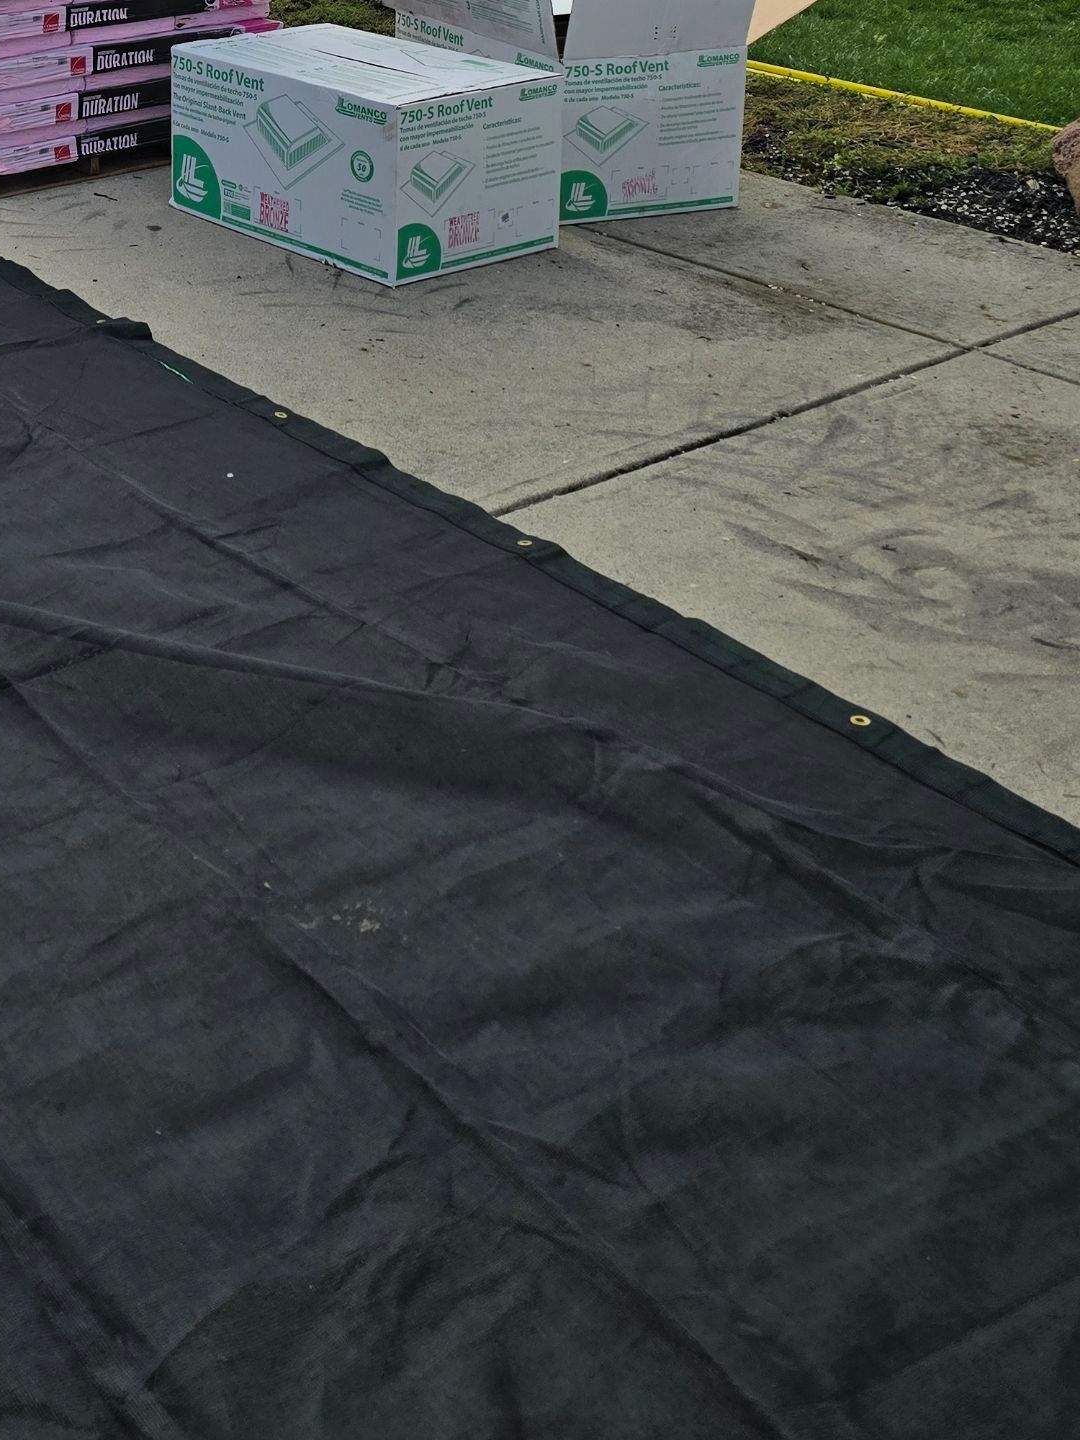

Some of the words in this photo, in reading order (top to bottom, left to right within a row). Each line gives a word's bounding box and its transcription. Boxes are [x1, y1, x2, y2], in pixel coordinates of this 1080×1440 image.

[70, 8, 128, 28] DURATION
[397, 12, 419, 31] 750-S
[420, 20, 442, 39] Roof
[442, 27, 464, 47] Vent
[97, 50, 154, 71] DURATION
[516, 52, 555, 72] LOMANCO
[698, 53, 740, 63] LOMANCO
[173, 55, 203, 75] 750-S
[206, 64, 234, 84] Roof
[235, 71, 265, 92] Vent
[565, 65, 603, 79] 750-S
[606, 62, 638, 76] Roof
[638, 60, 669, 73] Vent
[520, 84, 557, 97] LOMANCO
[82, 93, 139, 117] DURATION
[232, 108, 246, 120] Vent
[337, 96, 387, 120] LOMANCO
[401, 106, 434, 125] 750-S
[438, 100, 467, 117] Roof
[466, 96, 494, 111] Vent
[81, 133, 138, 156] DURATION
